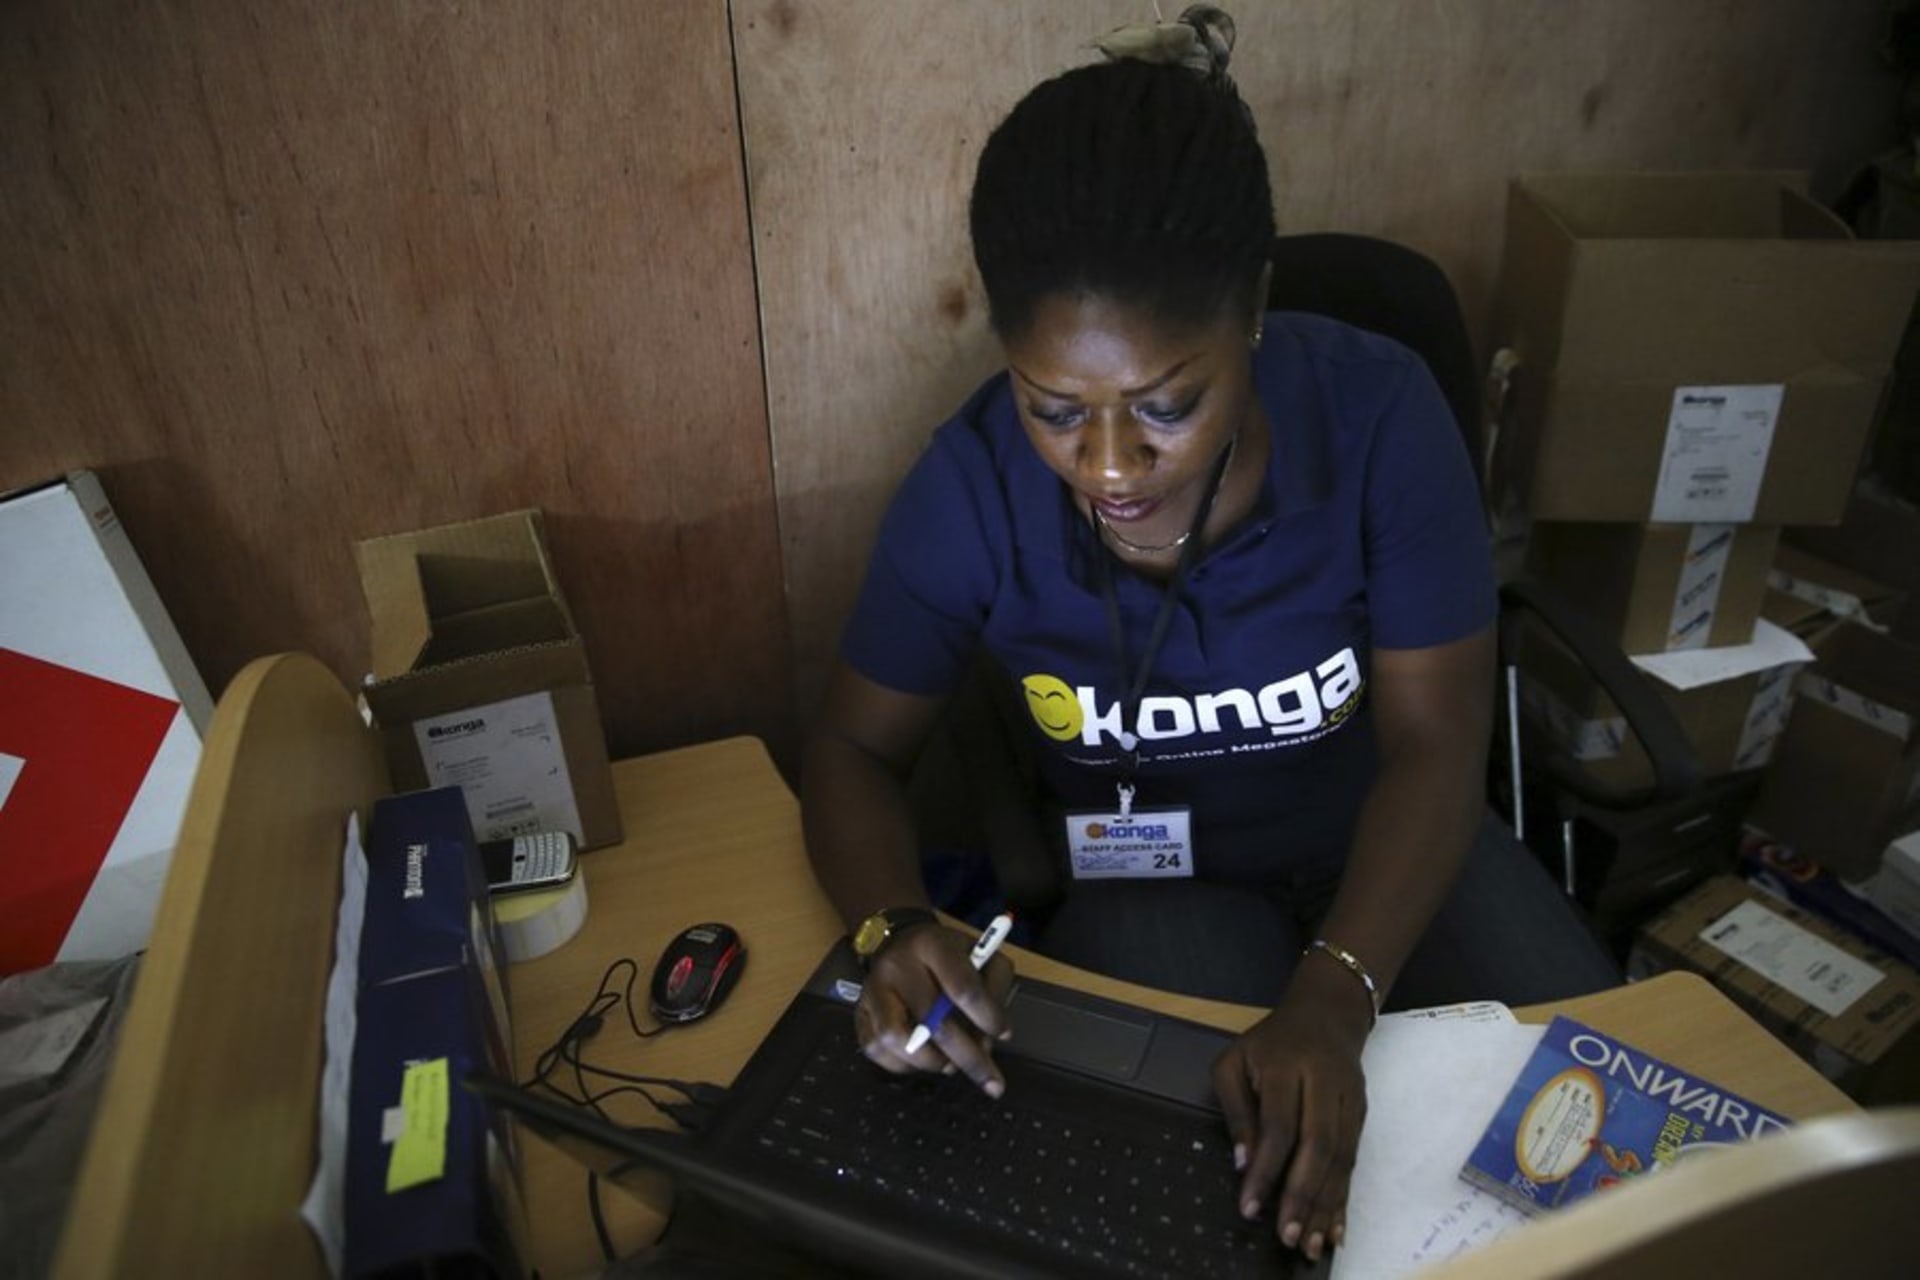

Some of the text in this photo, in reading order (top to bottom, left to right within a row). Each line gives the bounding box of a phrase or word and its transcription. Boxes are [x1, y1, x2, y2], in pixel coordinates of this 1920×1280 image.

[1076, 647, 1361, 746] konga
[1103, 823, 1168, 841] konga
[1113, 843, 1153, 852] ACCESS
[1153, 853, 1182, 869] 24
